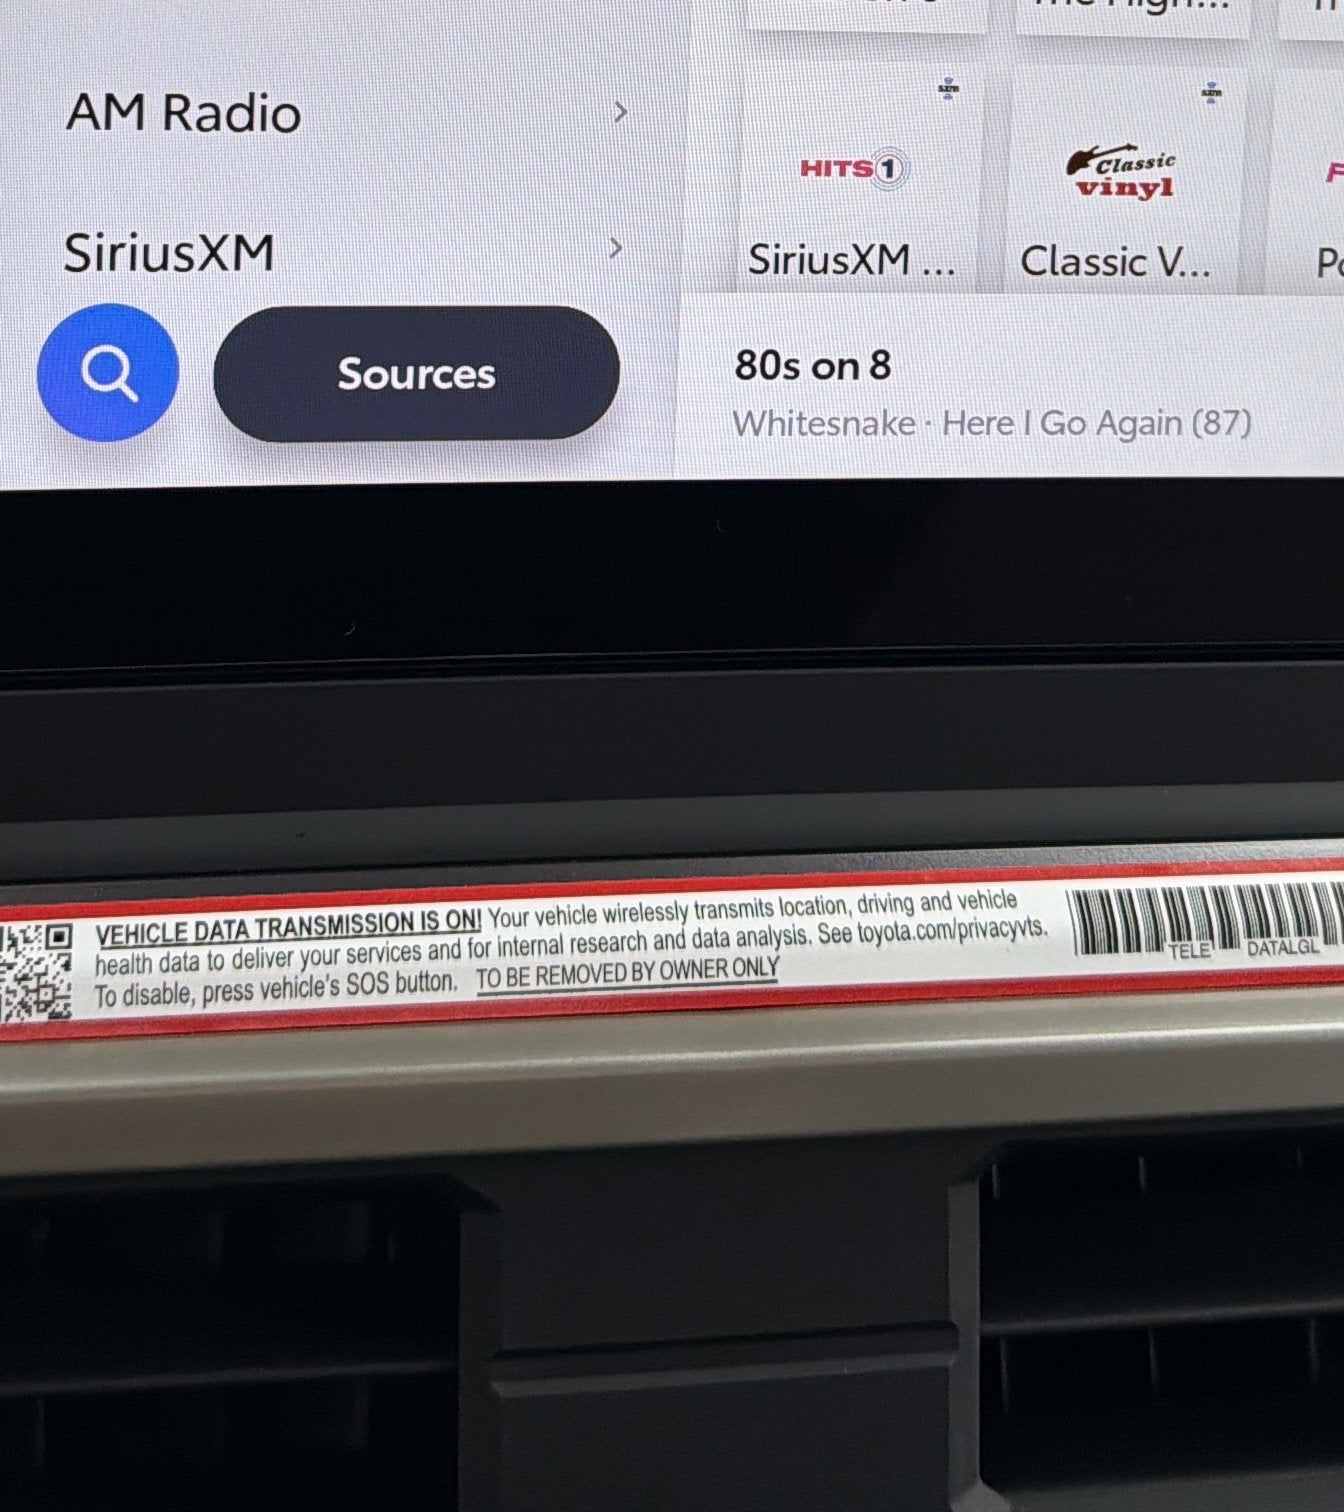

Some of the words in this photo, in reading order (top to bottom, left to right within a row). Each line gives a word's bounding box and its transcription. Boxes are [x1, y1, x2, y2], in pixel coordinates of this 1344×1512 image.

[65, 91, 145, 134] AM
[164, 91, 302, 135] Radio
[801, 159, 874, 178] HITS
[1095, 152, 1177, 175] Classic
[1075, 177, 1174, 201] vinyl
[64, 231, 276, 274] SiriusXM
[748, 242, 910, 279] SiriusXM
[1021, 245, 1148, 280] Classic
[337, 355, 497, 392] Sources
[734, 348, 801, 383] 80s
[811, 355, 860, 383] on
[869, 349, 892, 383] 8
[733, 409, 917, 438] Whitesnake
[942, 409, 1015, 438] Here
[1023, 409, 1031, 437] I
[1040, 409, 1088, 438] Go
[1095, 409, 1184, 446] Again
[1192, 406, 1253, 442] (87)
[96, 921, 188, 946] VEHICLE
[195, 917, 250, 942] DATA
[255, 910, 415, 939] TRANSMISSION
[421, 909, 440, 931] IS
[446, 907, 482, 930] ON!
[488, 906, 530, 929] Your
[535, 903, 597, 926] vehicle
[603, 899, 689, 926] wirelessly
[694, 896, 775, 920] transmits
[779, 894, 853, 918] location,
[857, 892, 915, 917] driving
[920, 890, 953, 912] and
[957, 888, 1018, 910] vehicle
[95, 951, 153, 977] health
[159, 950, 200, 973] data
[207, 950, 225, 971] to
[232, 946, 295, 970] deliver
[300, 947, 341, 972] your
[346, 940, 422, 964] services
[428, 937, 462, 960] and
[468, 936, 492, 959] for
[497, 932, 565, 957] internal
[570, 929, 648, 954] research
[653, 926, 686, 950] and
[692, 926, 731, 950] data
[736, 923, 812, 951] analysis.
[818, 922, 853, 945] See
[857, 914, 1049, 948] toyota.com/privacyvts.
[1168, 942, 1211, 960] TELE
[1247, 938, 1321, 957] DATALGL
[95, 983, 117, 1009] To
[122, 980, 196, 1007] disable,
[203, 981, 254, 1009] press
[259, 973, 340, 1000] vehicle's
[346, 970, 390, 996] SOS
[396, 970, 458, 994] button.
[476, 967, 502, 989] TO
[507, 966, 531, 988] BE
[536, 962, 628, 986] REMOVED
[632, 960, 656, 982] BY
[660, 957, 729, 981] OWNER
[733, 954, 781, 977] ONLY
